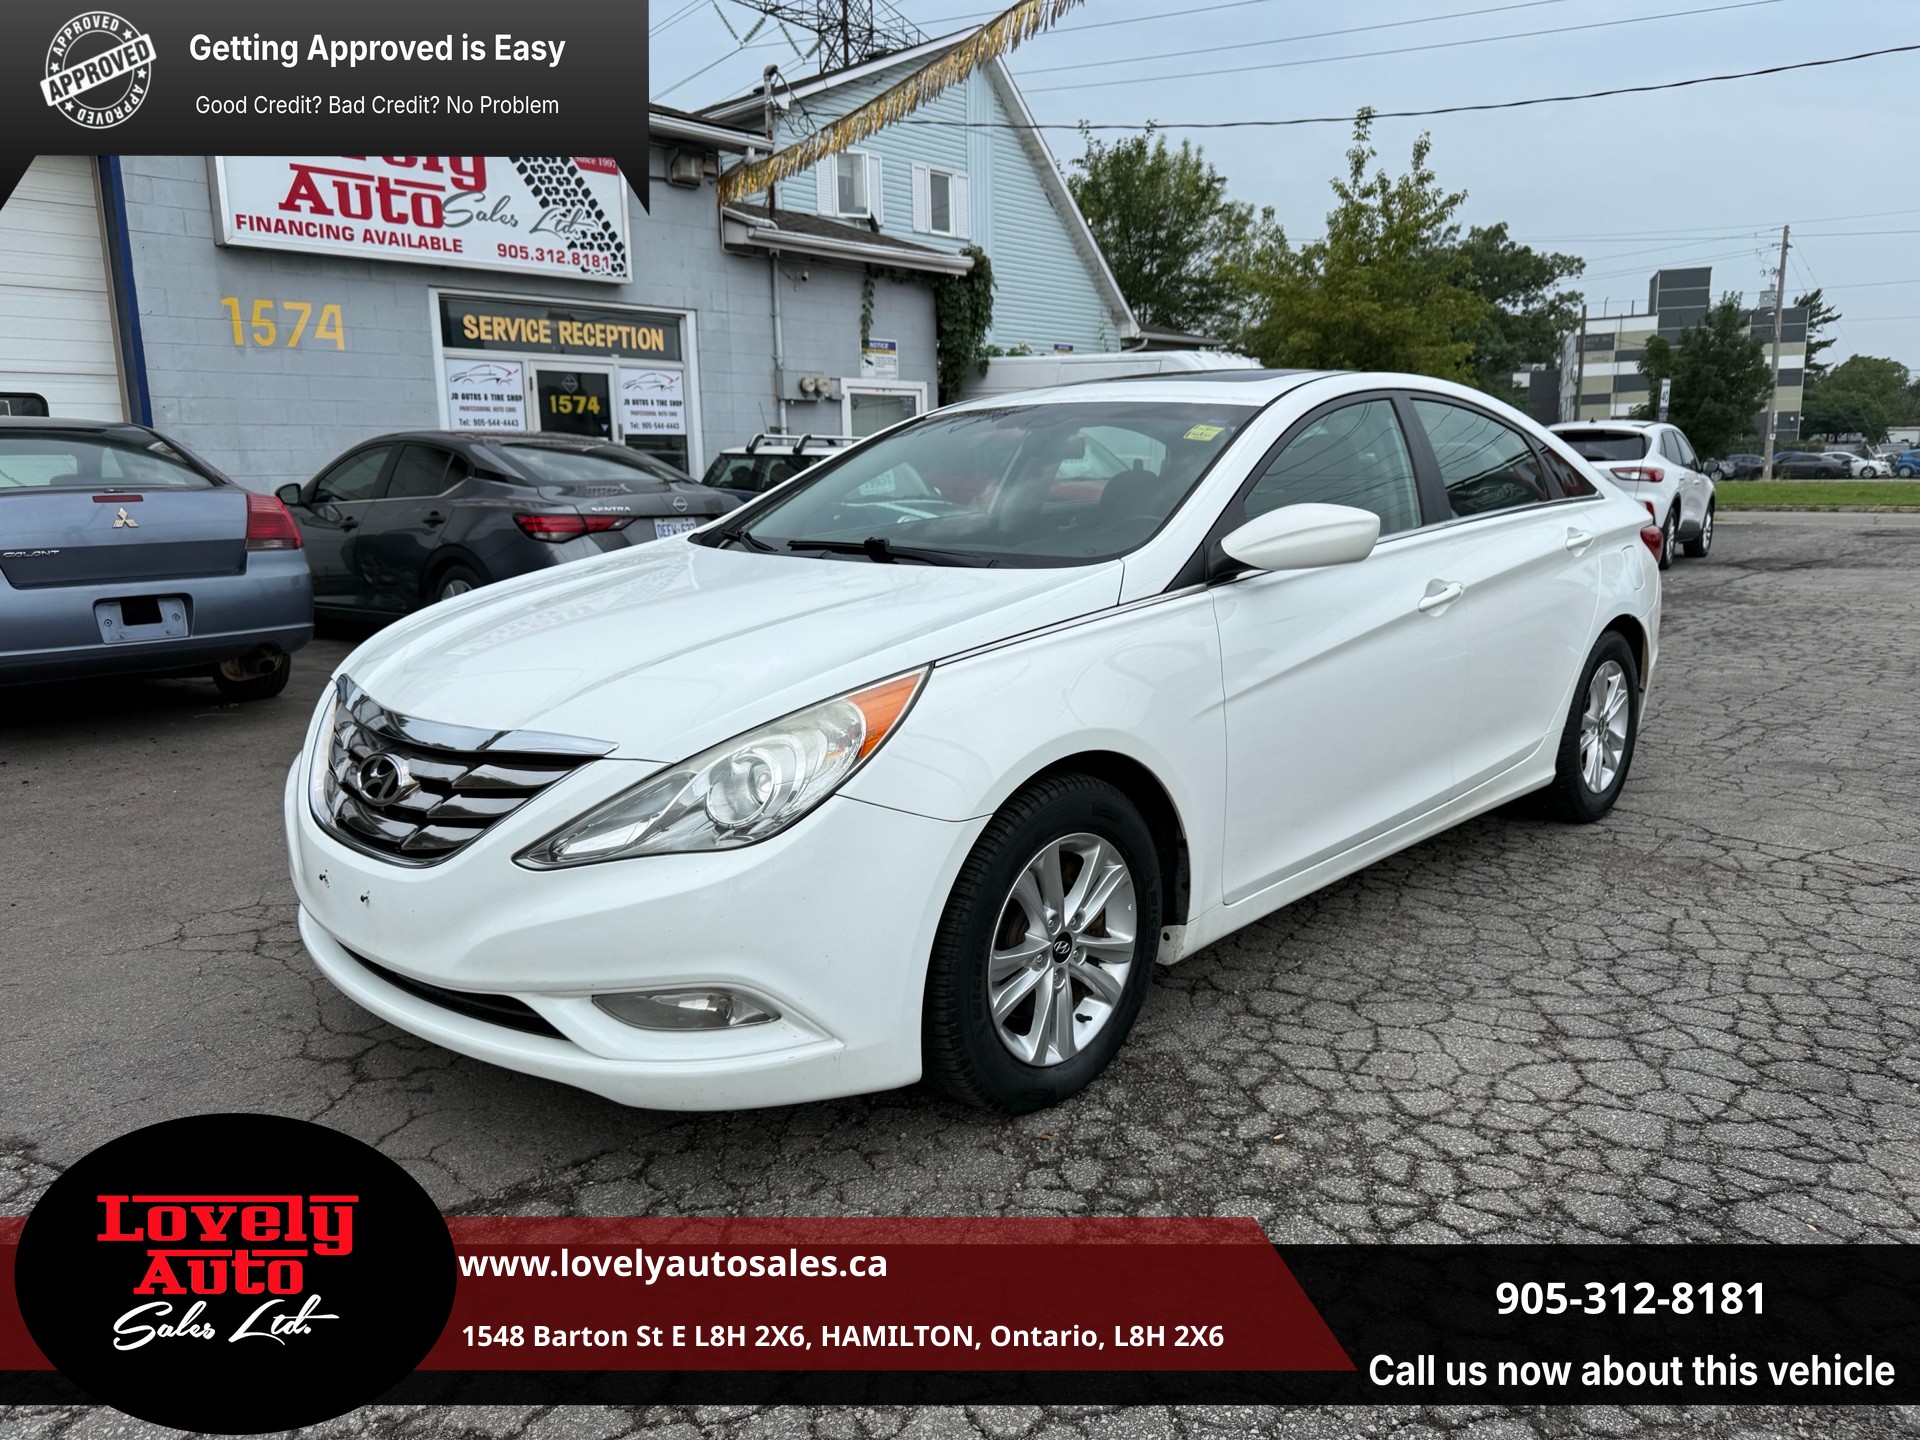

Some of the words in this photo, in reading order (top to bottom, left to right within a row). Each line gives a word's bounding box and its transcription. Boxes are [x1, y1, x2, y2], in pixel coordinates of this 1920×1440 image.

[278, 163, 446, 230] Auto
[443, 191, 519, 228] Sales
[236, 214, 354, 241] FINANCING
[362, 229, 464, 253] AVAILABLE
[497, 243, 611, 269] 905.312.8181
[221, 297, 345, 350] 1574
[463, 314, 552, 344] SERVICE
[558, 320, 664, 351] RECEPTION
[490, 393, 505, 402] TIRE
[550, 395, 600, 415] 1574
